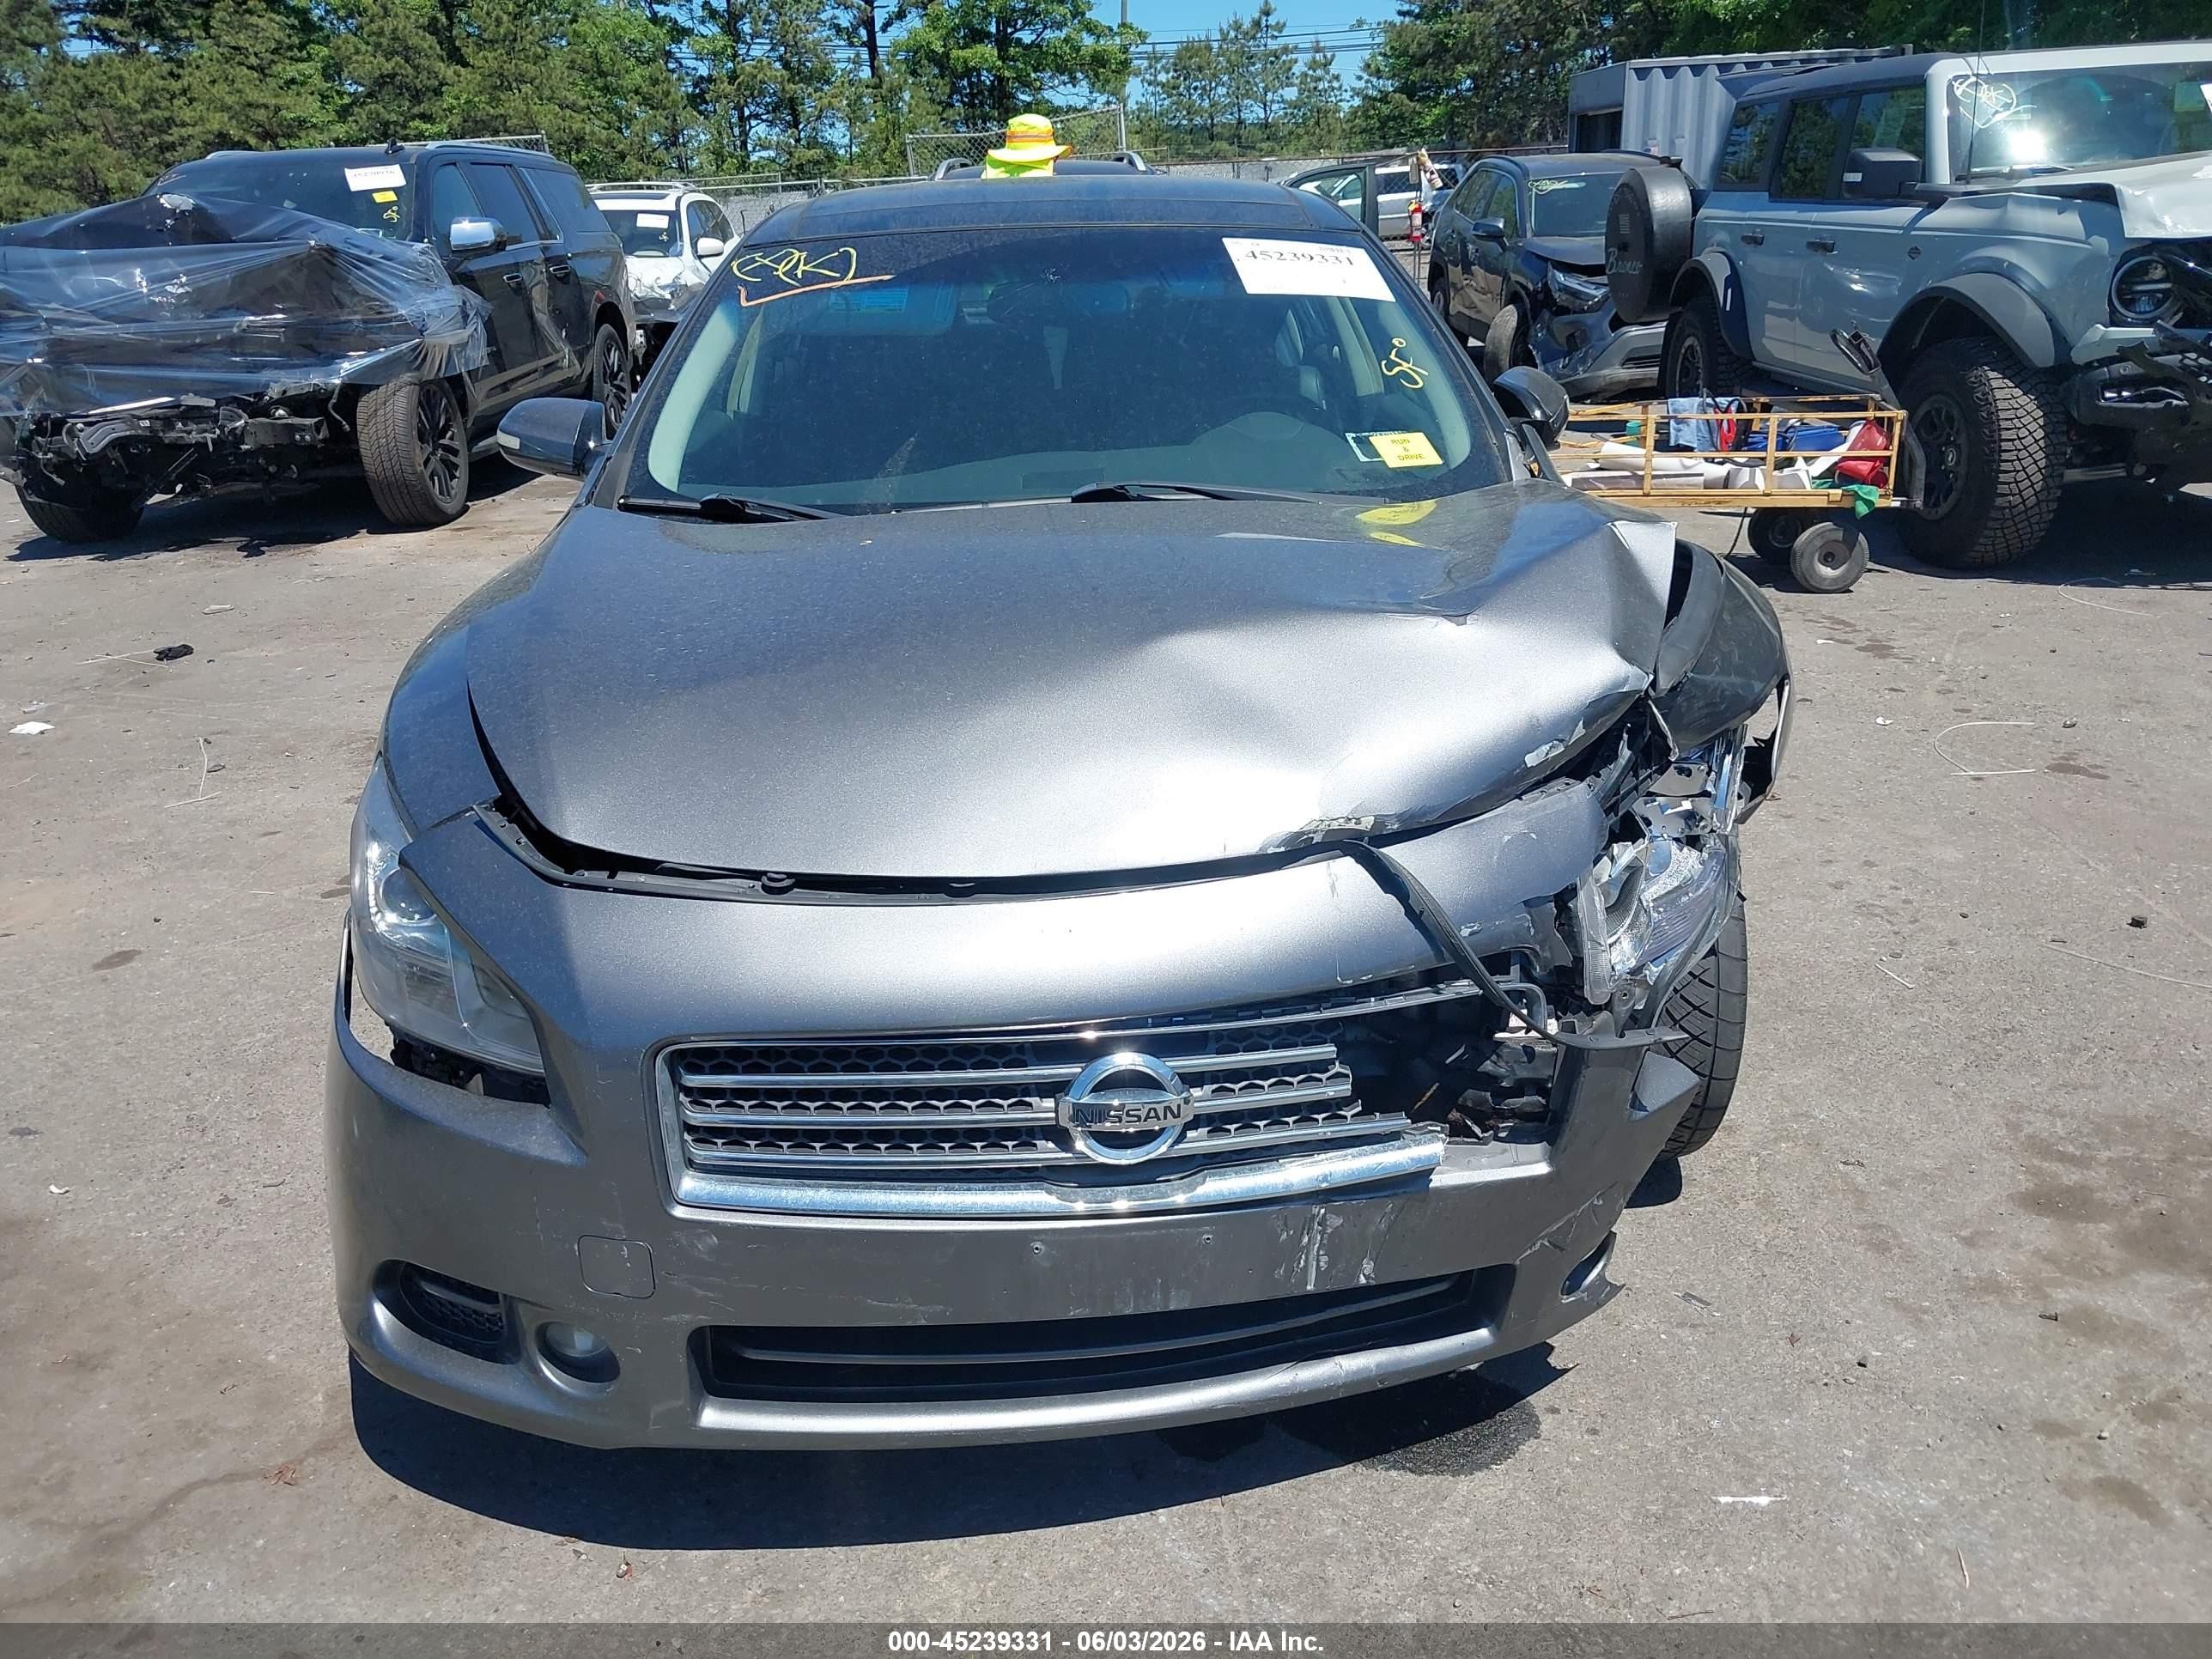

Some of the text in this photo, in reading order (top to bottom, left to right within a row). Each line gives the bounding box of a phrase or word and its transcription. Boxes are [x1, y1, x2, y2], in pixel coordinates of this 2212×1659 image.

[1245, 250, 1354, 266] 45239331
[1607, 247, 1643, 275] Bronco
[1075, 1103, 1182, 1125] NISSAN
